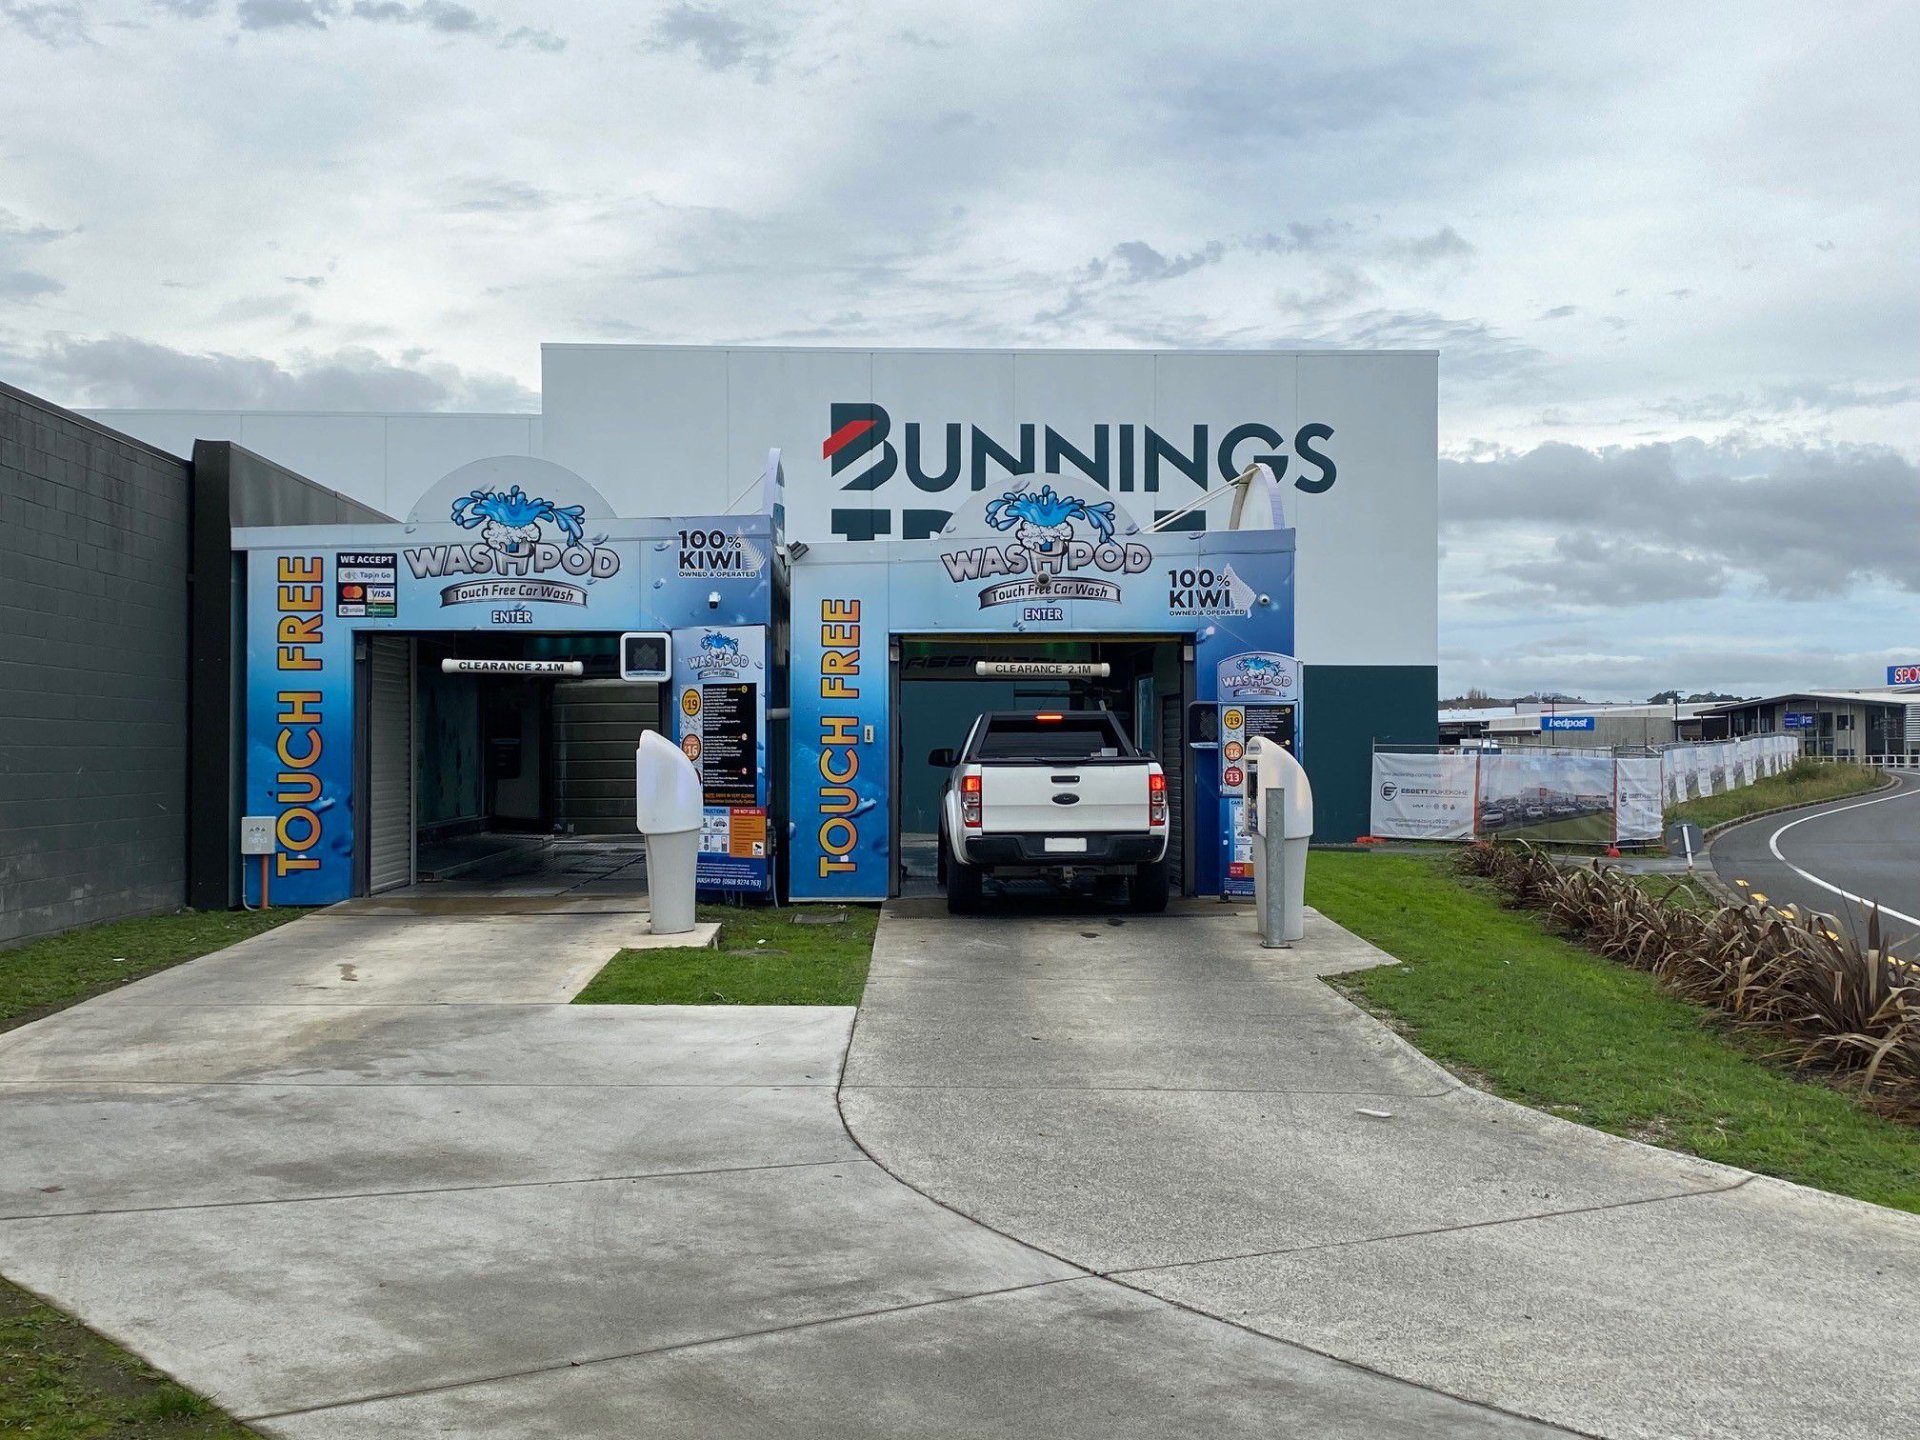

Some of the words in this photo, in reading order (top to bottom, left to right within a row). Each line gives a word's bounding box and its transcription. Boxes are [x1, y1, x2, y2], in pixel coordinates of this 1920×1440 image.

[823, 403, 1337, 494] BUNNINGS
[678, 530, 741, 549] 100%
[340, 555, 355, 564] WE
[356, 555, 394, 564] ACCEPT
[679, 551, 741, 569] KIWI
[1168, 569, 1230, 588] 100%
[371, 590, 391, 598] VISA
[453, 583, 489, 602] Touch
[491, 584, 516, 597] Free
[519, 584, 539, 596] Car
[541, 585, 574, 602] Wash
[991, 585, 1025, 602] Touch
[1028, 584, 1051, 595] Free
[1054, 583, 1073, 595] Car
[1076, 584, 1108, 598] Wash
[1169, 589, 1230, 608] KIWI
[277, 556, 323, 671] FREE
[491, 610, 533, 624] ENTER
[1024, 608, 1063, 621] ENTER
[820, 599, 861, 699] FREE
[458, 661, 532, 672] CLEARANCE
[534, 662, 565, 673] 2.1M
[995, 664, 1063, 674] CLEARANCE
[1068, 664, 1091, 675] 2.1M
[276, 690, 323, 878] TOUCH
[818, 715, 860, 878] TOUCH
